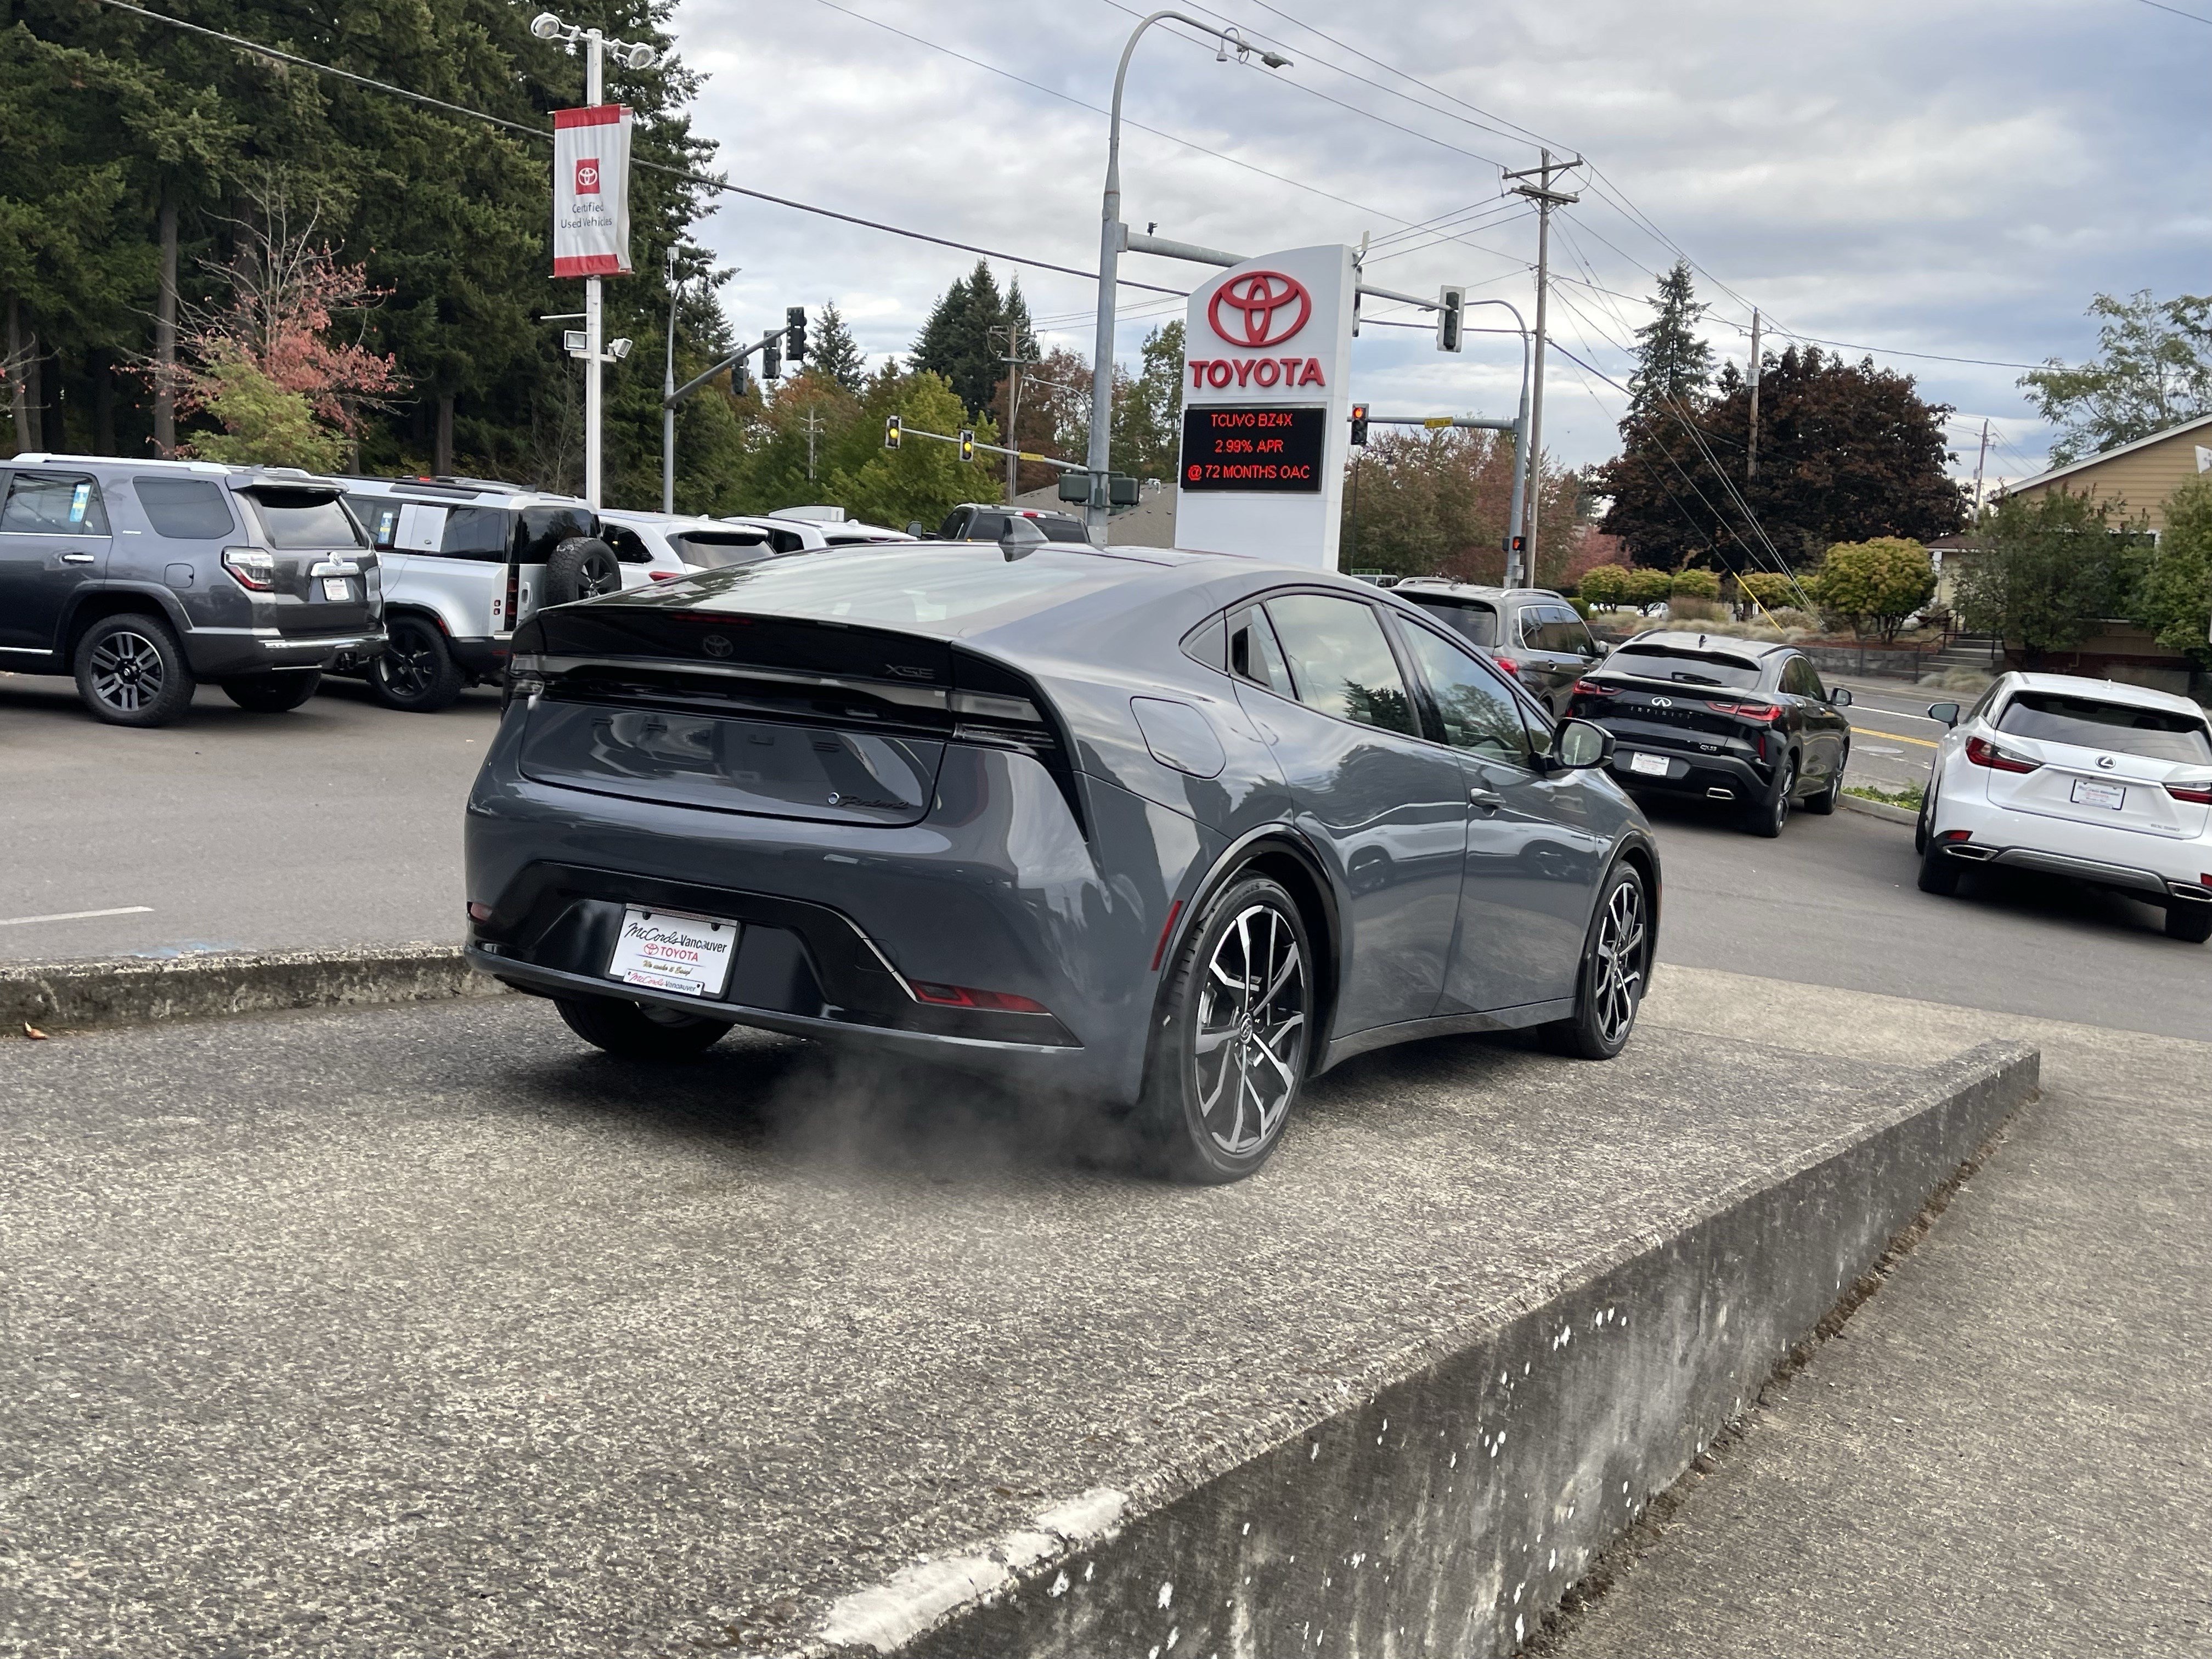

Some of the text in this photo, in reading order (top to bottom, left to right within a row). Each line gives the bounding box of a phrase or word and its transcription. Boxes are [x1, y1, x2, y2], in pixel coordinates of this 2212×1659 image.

[572, 201, 603, 213] Certified
[561, 216, 612, 228] Used Vehicles
[1188, 358, 1325, 388] TOYOTA
[1211, 413, 1293, 428] TCUVG BZ4X
[1214, 439, 1284, 454] 2.99% APR
[1187, 465, 1310, 481] @ 72 MONTHS OAC
[661, 946, 698, 962] TOYOTA
